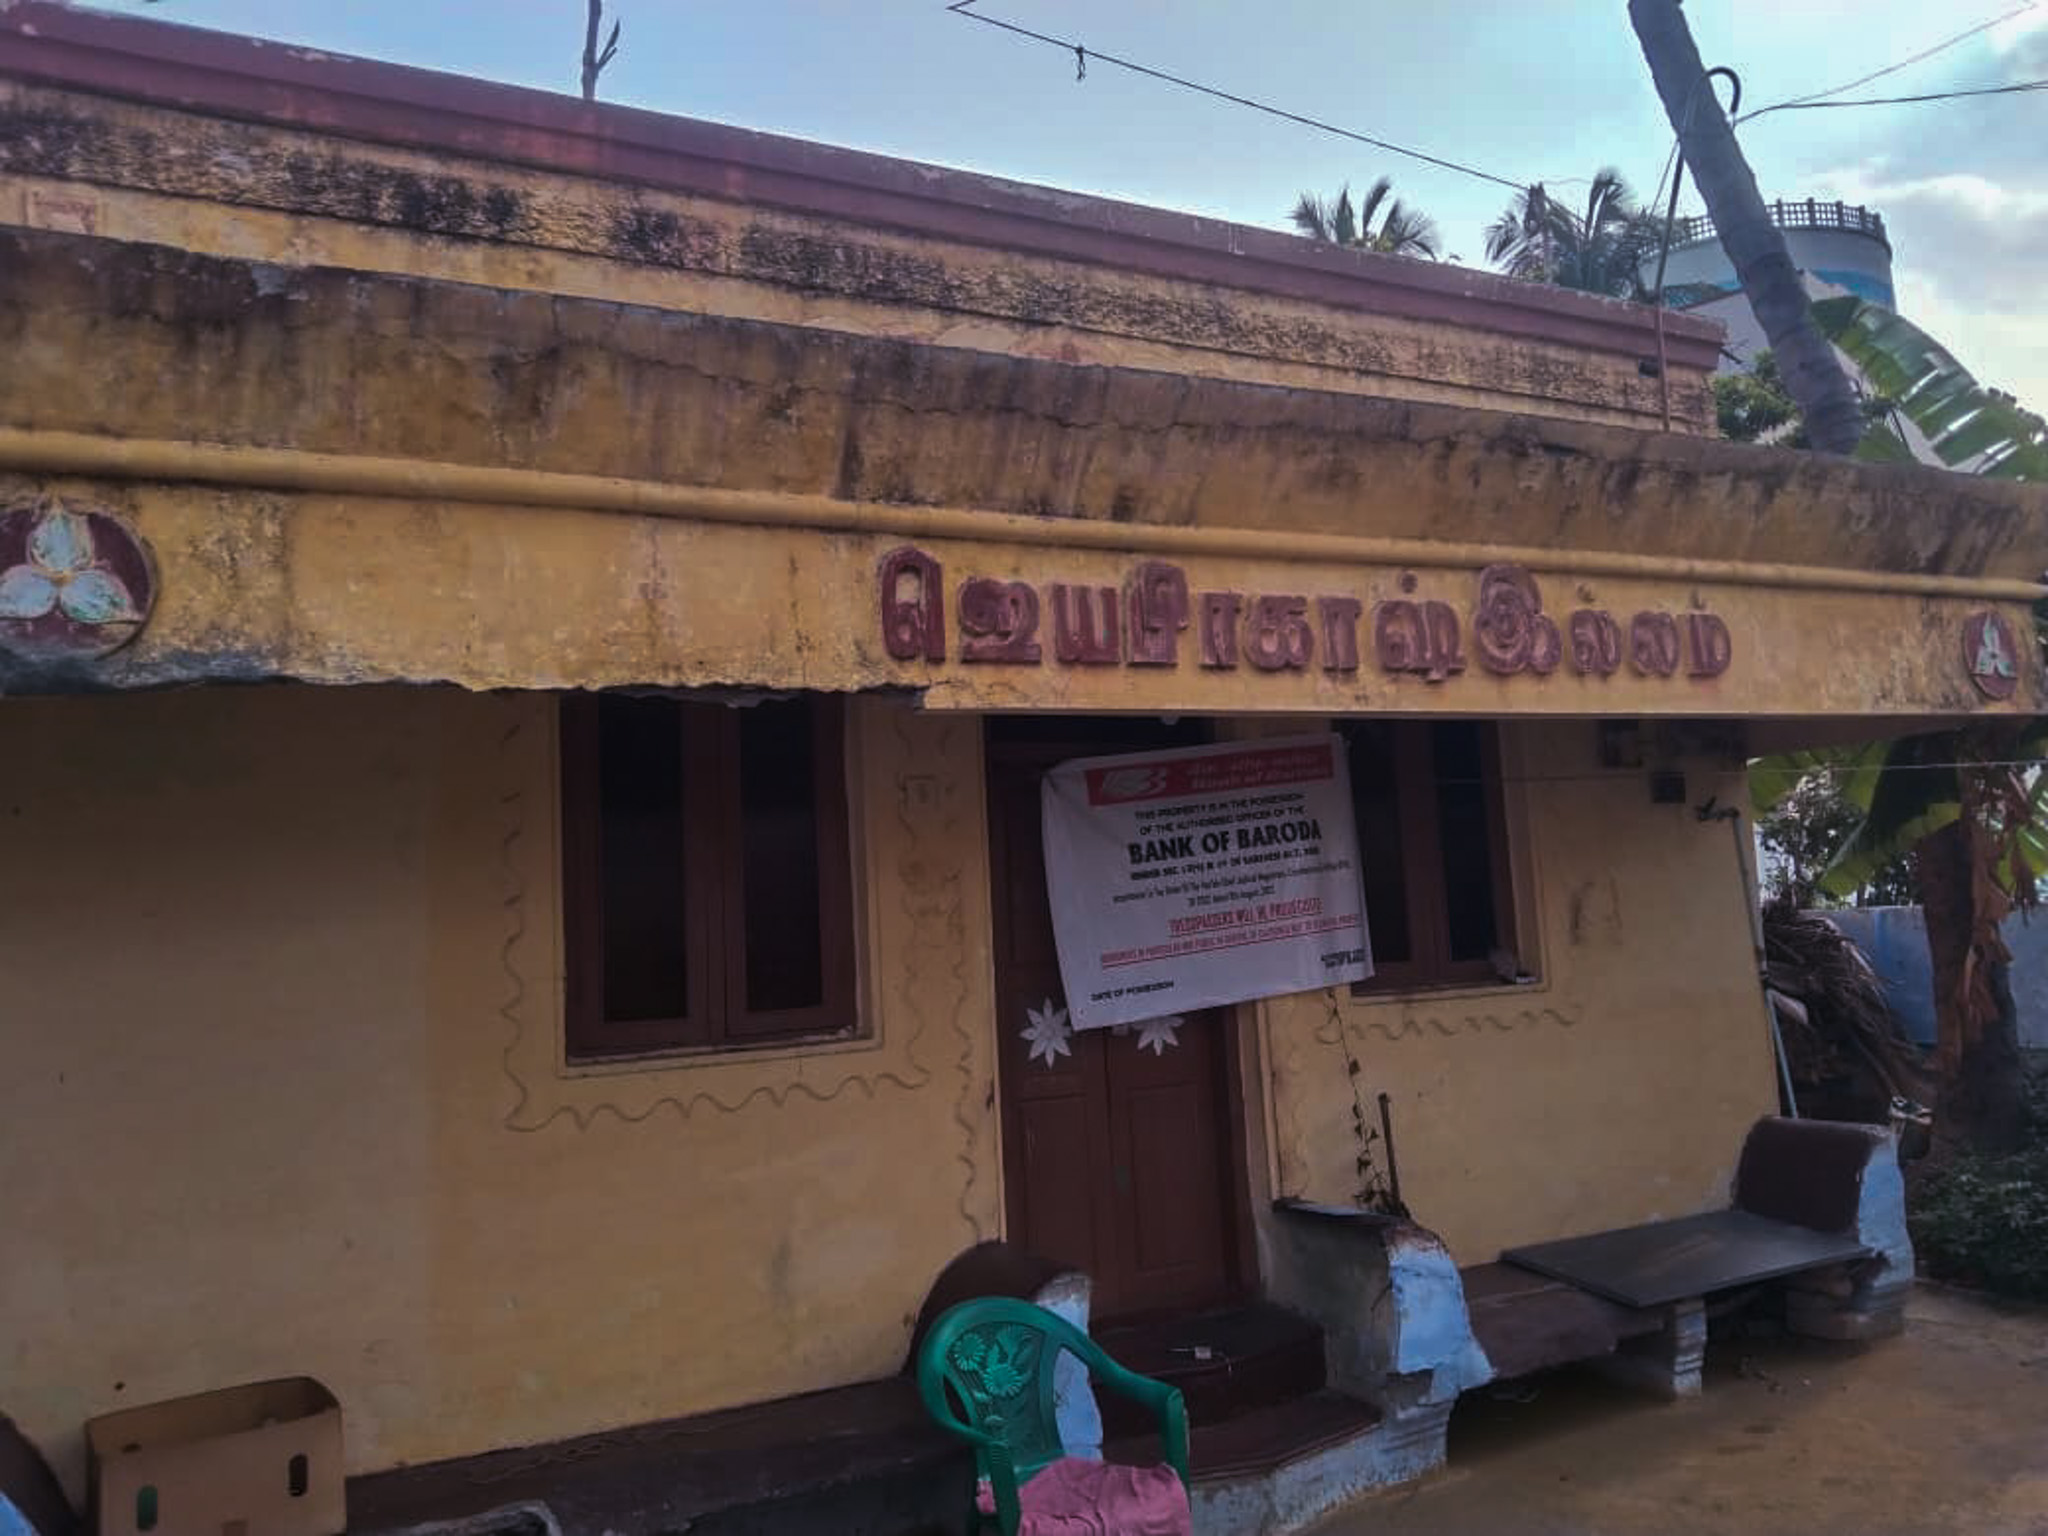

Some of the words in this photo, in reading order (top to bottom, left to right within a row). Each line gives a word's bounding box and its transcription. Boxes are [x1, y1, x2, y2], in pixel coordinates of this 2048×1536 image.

[1229, 799, 1249, 809] THE
[1139, 825, 1151, 836] OF
[1152, 822, 1174, 835] THE
[1286, 805, 1305, 815] THE
[1128, 836, 1196, 866] BANK
[1202, 830, 1231, 855] OF
[1237, 818, 1322, 850] BARODA
[1090, 990, 1113, 1002] DATE
